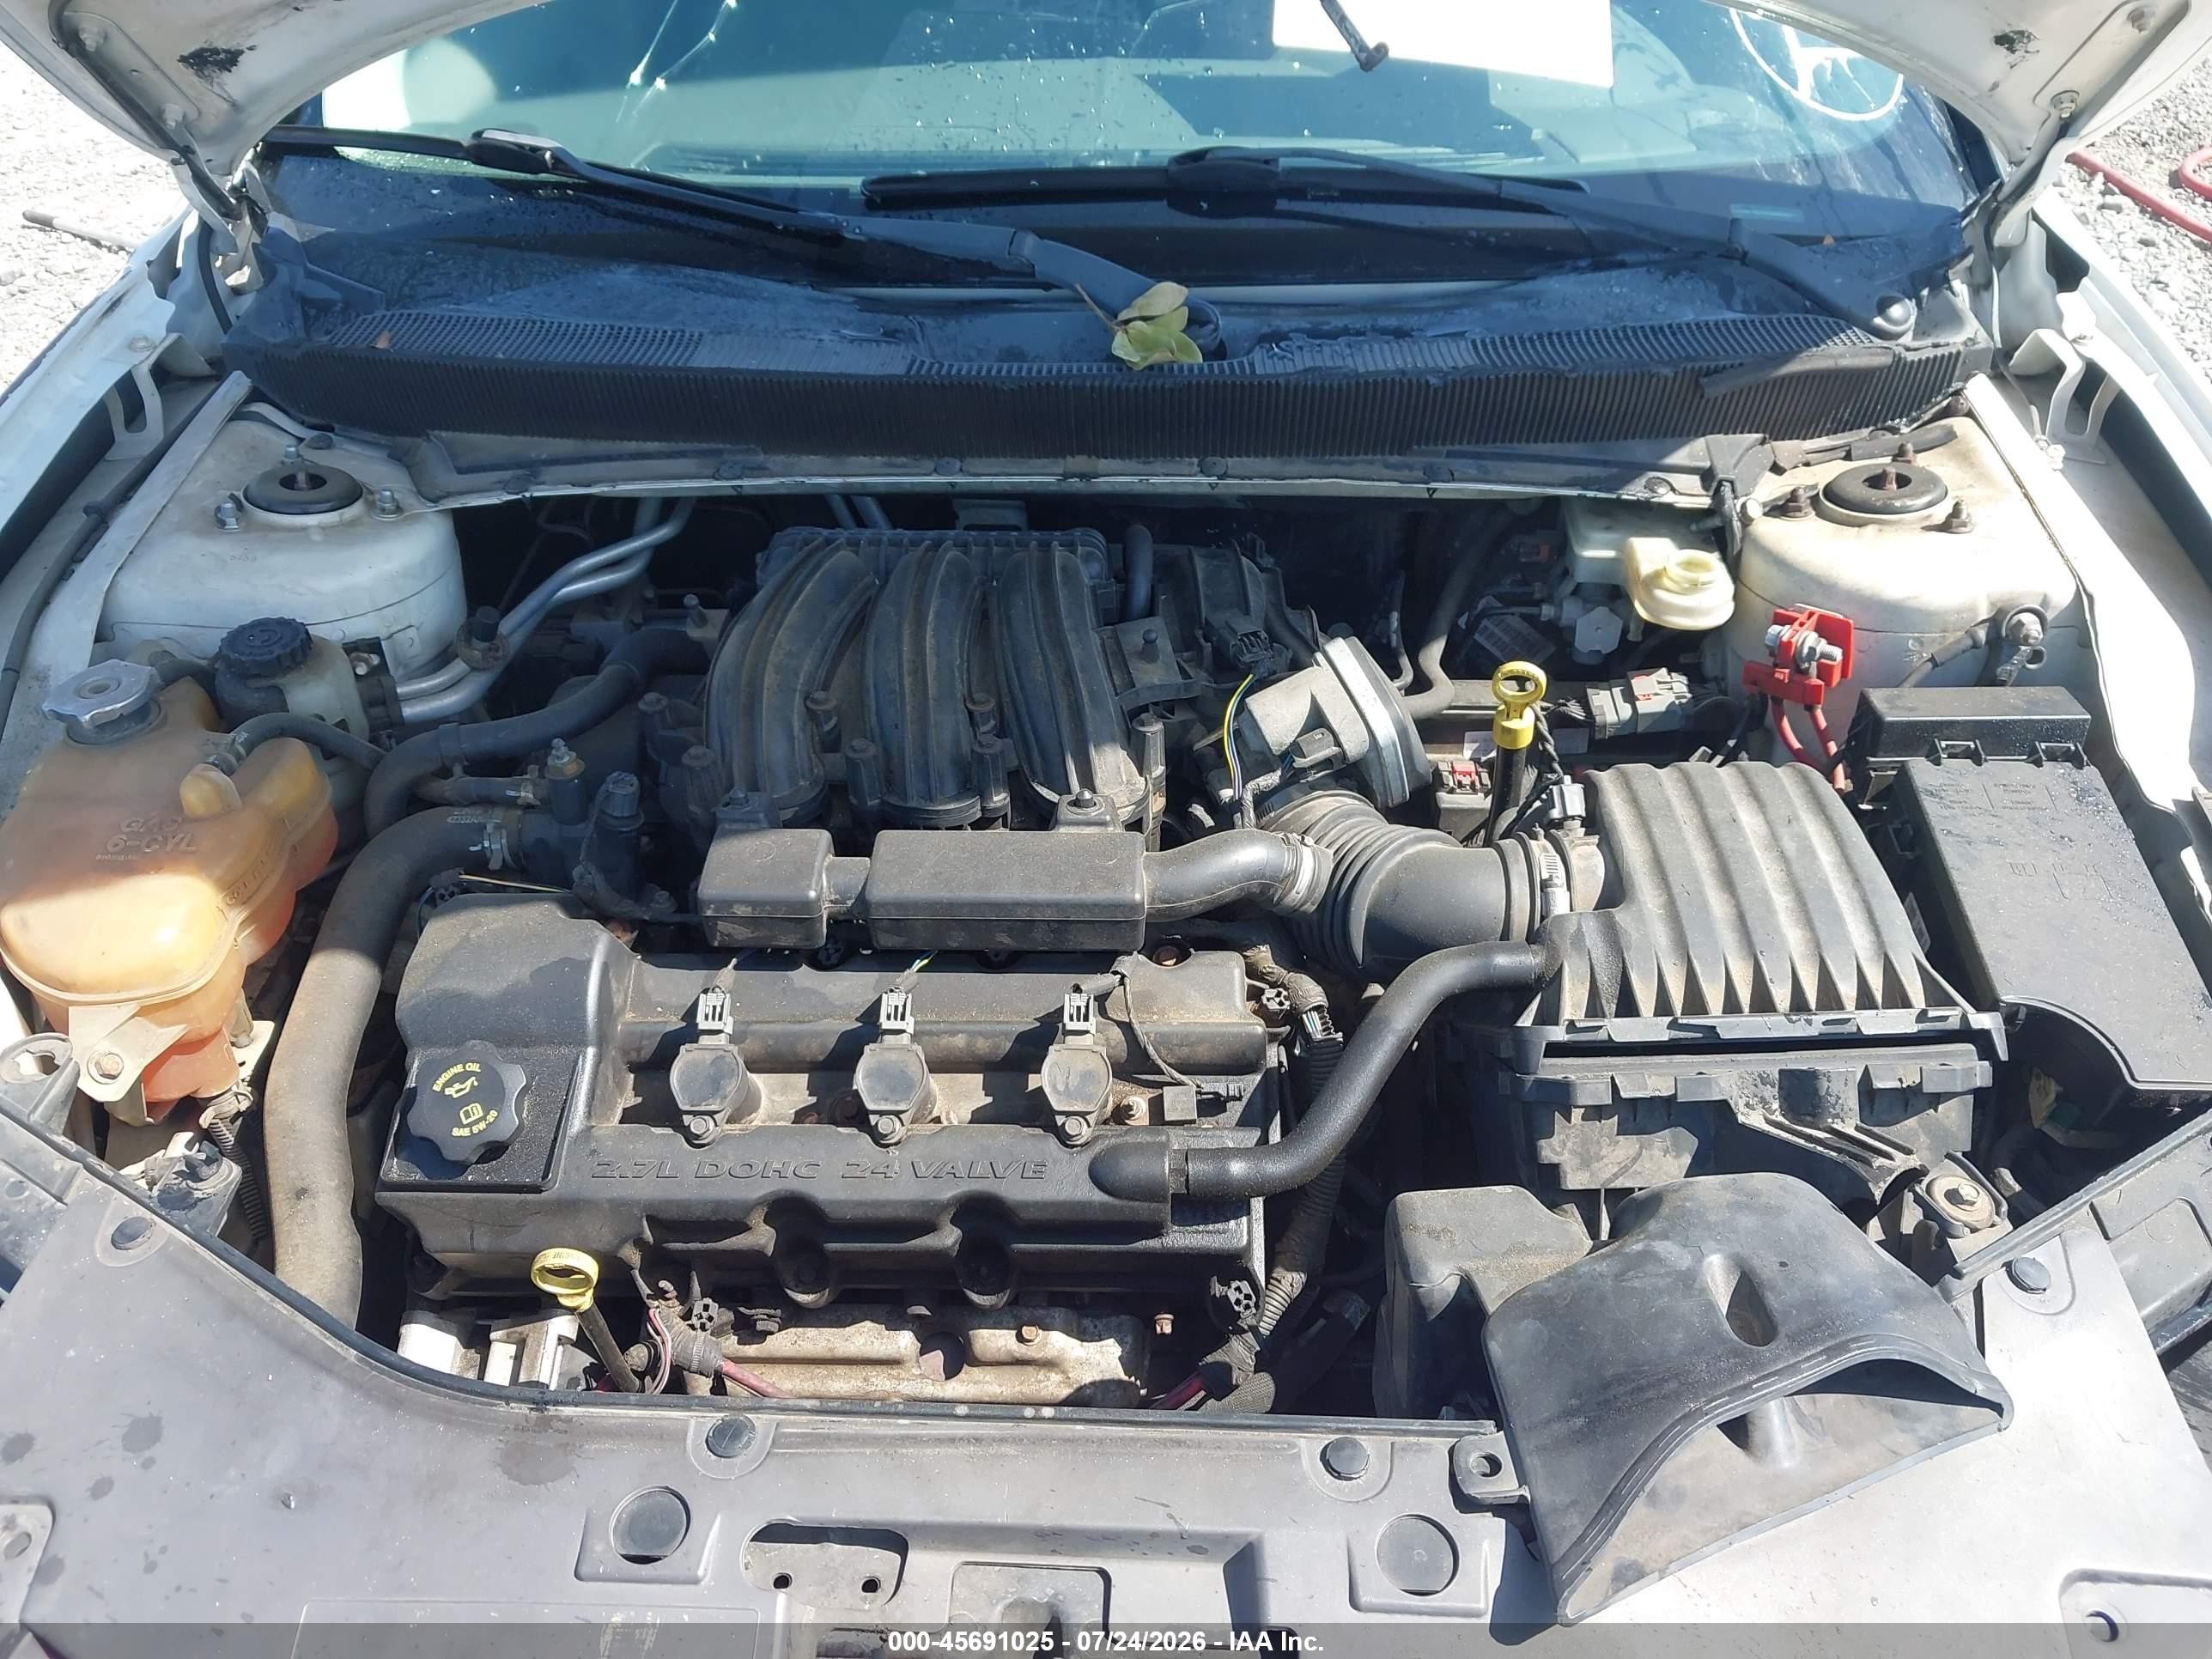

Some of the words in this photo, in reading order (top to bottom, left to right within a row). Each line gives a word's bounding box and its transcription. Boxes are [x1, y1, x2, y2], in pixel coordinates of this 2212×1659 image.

[106, 833, 198, 853] 6-CYL
[432, 1063, 465, 1092] ENGINE
[465, 1062, 481, 1073] OIL
[451, 1127, 471, 1137] SAE
[471, 1109, 498, 1134] 5W-20
[591, 1159, 681, 1179] 2.7L
[694, 1159, 821, 1179] DOHC
[841, 1159, 898, 1179] 24
[911, 1159, 1048, 1180] VALVE
